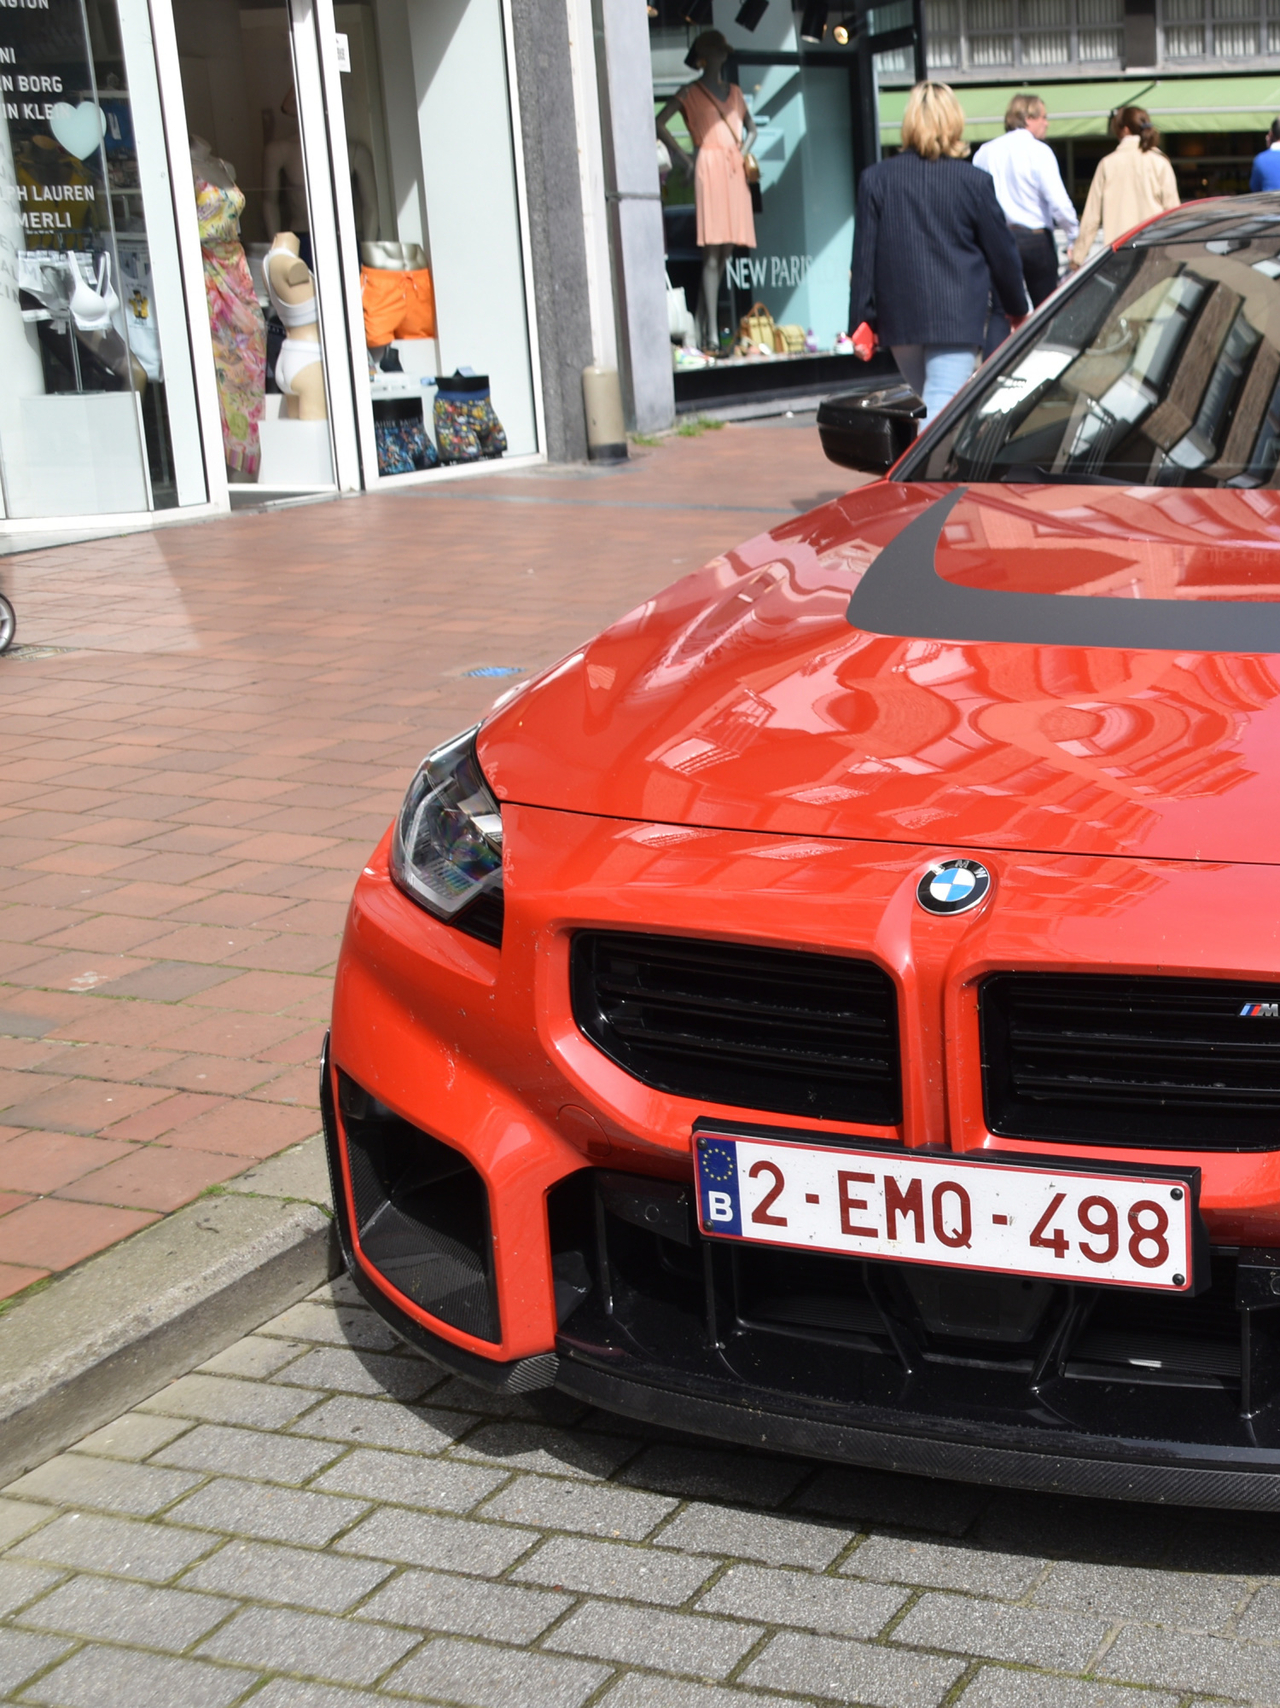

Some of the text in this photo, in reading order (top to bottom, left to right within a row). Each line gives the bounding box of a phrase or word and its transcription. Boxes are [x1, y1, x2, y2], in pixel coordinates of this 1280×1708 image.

[18, 76, 63, 93] BORG
[33, 185, 95, 202] LAUREN
[726, 255, 813, 290] NEW PARIS
[709, 1191, 733, 1222] B
[748, 1160, 1170, 1268] 2-EMQ-498
